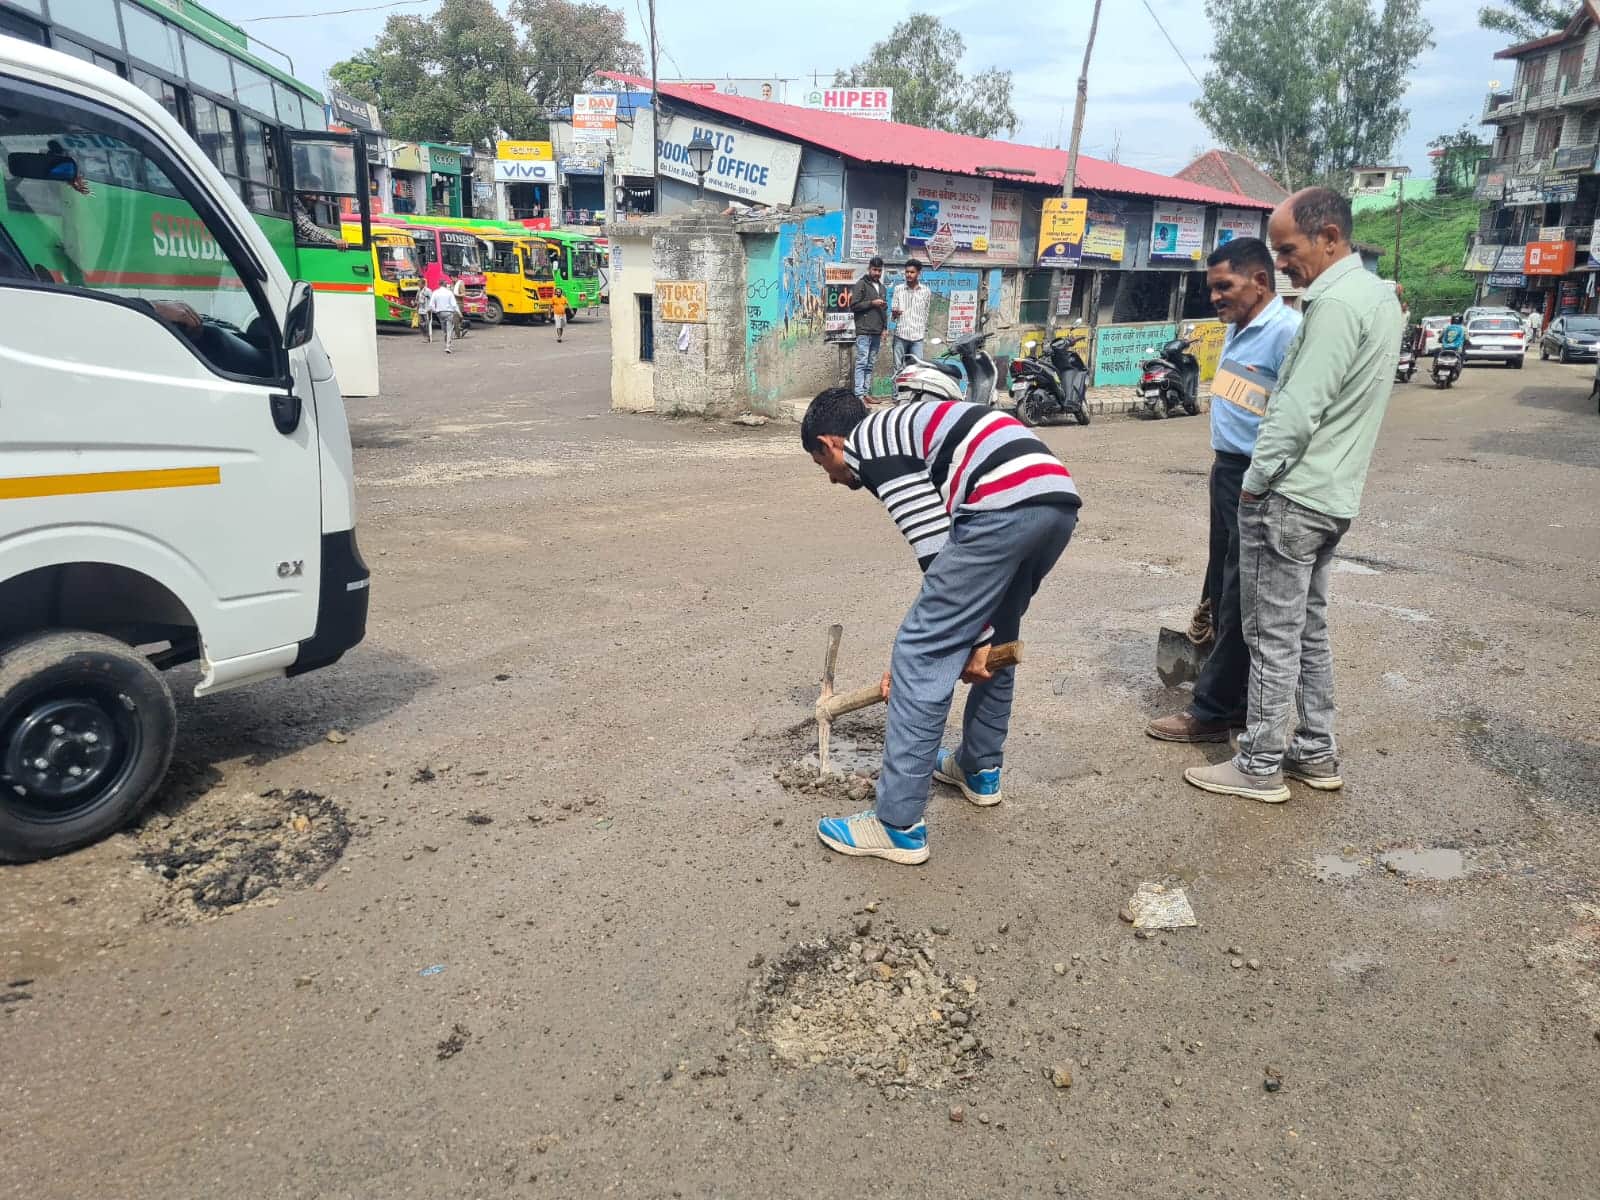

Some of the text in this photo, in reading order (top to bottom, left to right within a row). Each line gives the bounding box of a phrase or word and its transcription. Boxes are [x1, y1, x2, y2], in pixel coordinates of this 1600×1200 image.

[588, 97, 614, 108] DAV
[824, 90, 887, 108] HIPER
[692, 127, 735, 154] HRTC
[502, 163, 546, 177] vivo
[717, 155, 769, 186] OFFICE
[277, 559, 303, 578] CX
